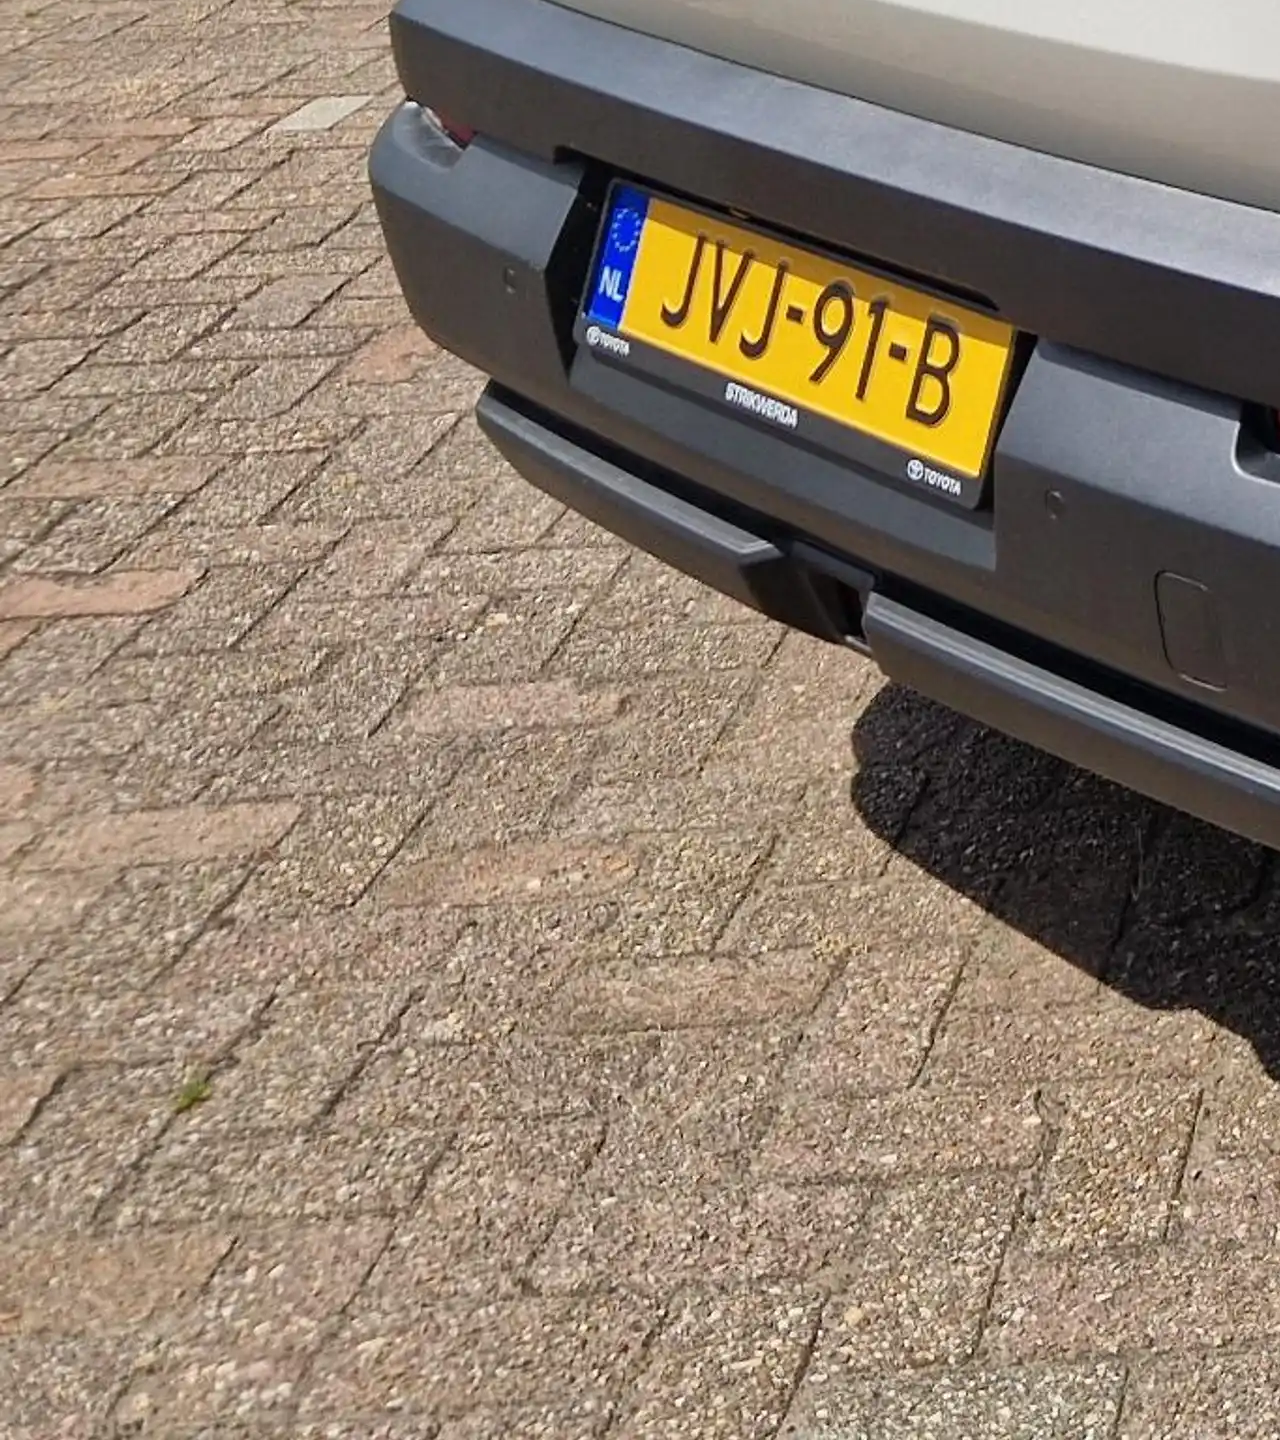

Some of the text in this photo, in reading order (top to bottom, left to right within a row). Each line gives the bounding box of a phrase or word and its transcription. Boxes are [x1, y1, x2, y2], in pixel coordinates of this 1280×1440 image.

[599, 265, 625, 301] NL
[600, 331, 630, 357] TOYOTA
[660, 233, 962, 429] JVJ-91-B
[725, 382, 798, 428] STRIKWERDA
[924, 466, 961, 496] TOYOTA
